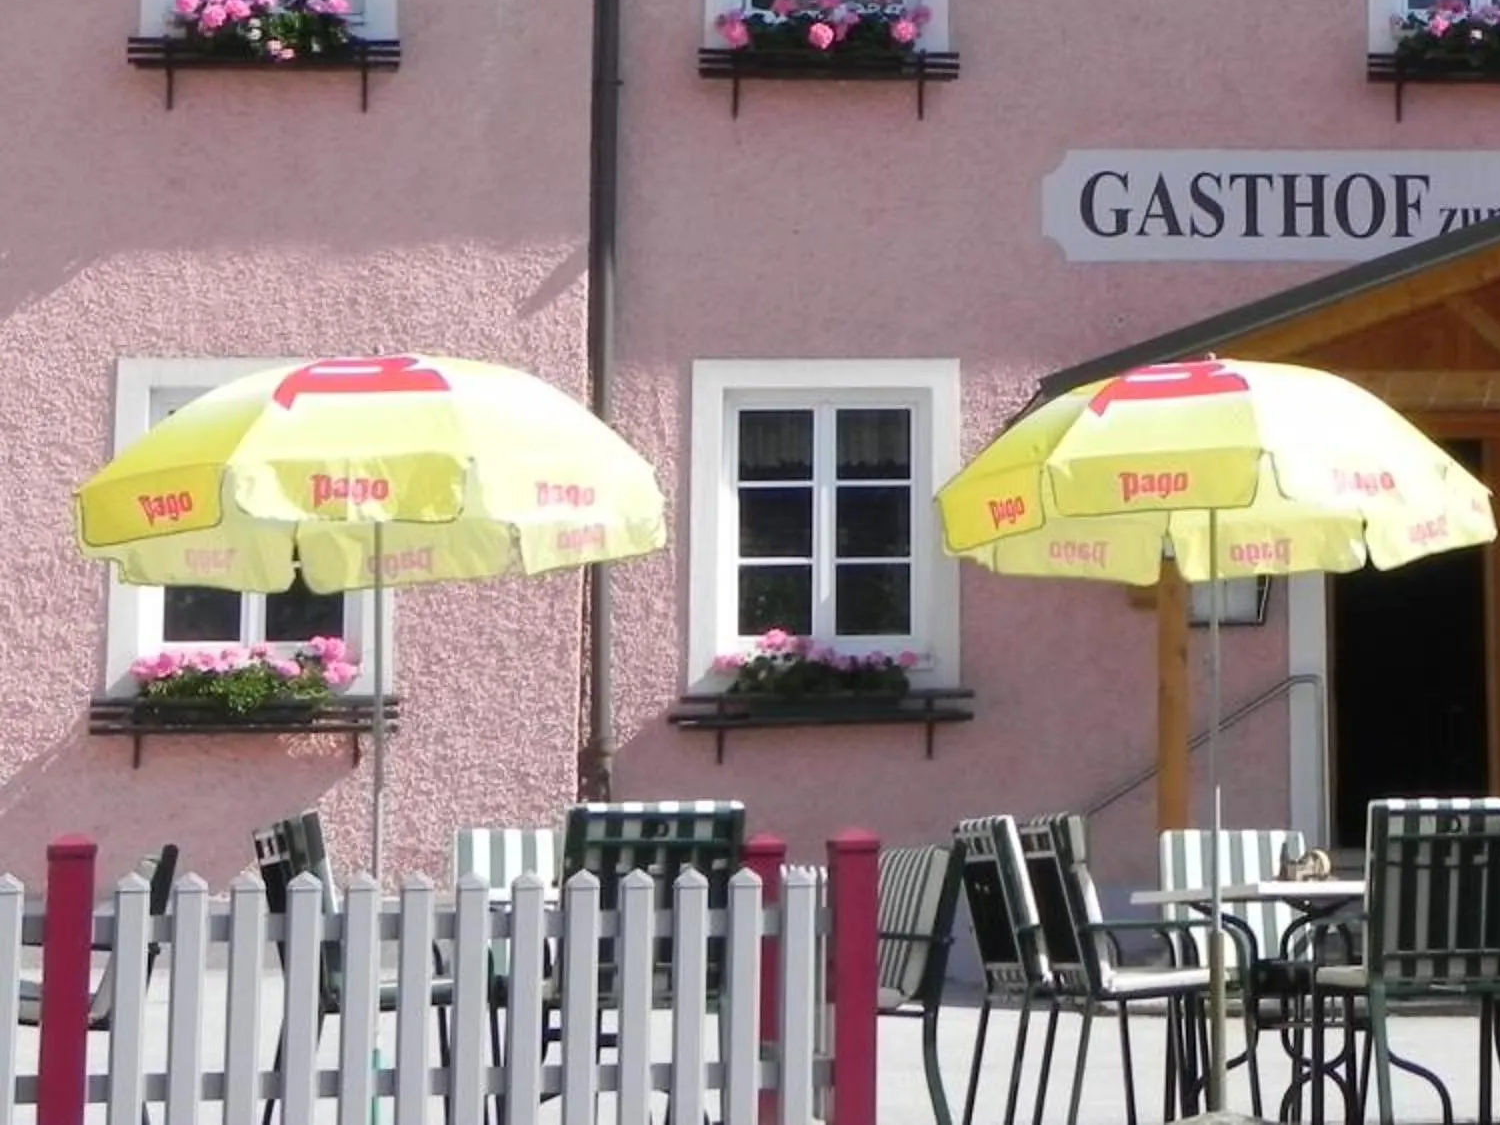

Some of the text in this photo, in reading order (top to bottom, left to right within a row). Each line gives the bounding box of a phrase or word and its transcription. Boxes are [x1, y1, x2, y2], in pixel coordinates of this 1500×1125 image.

[1079, 170, 1432, 239] GASTHOF
[311, 473, 390, 507] pago
[1119, 472, 1189, 503] pago
[138, 491, 193, 527] pago
[988, 495, 1026, 531] pago
